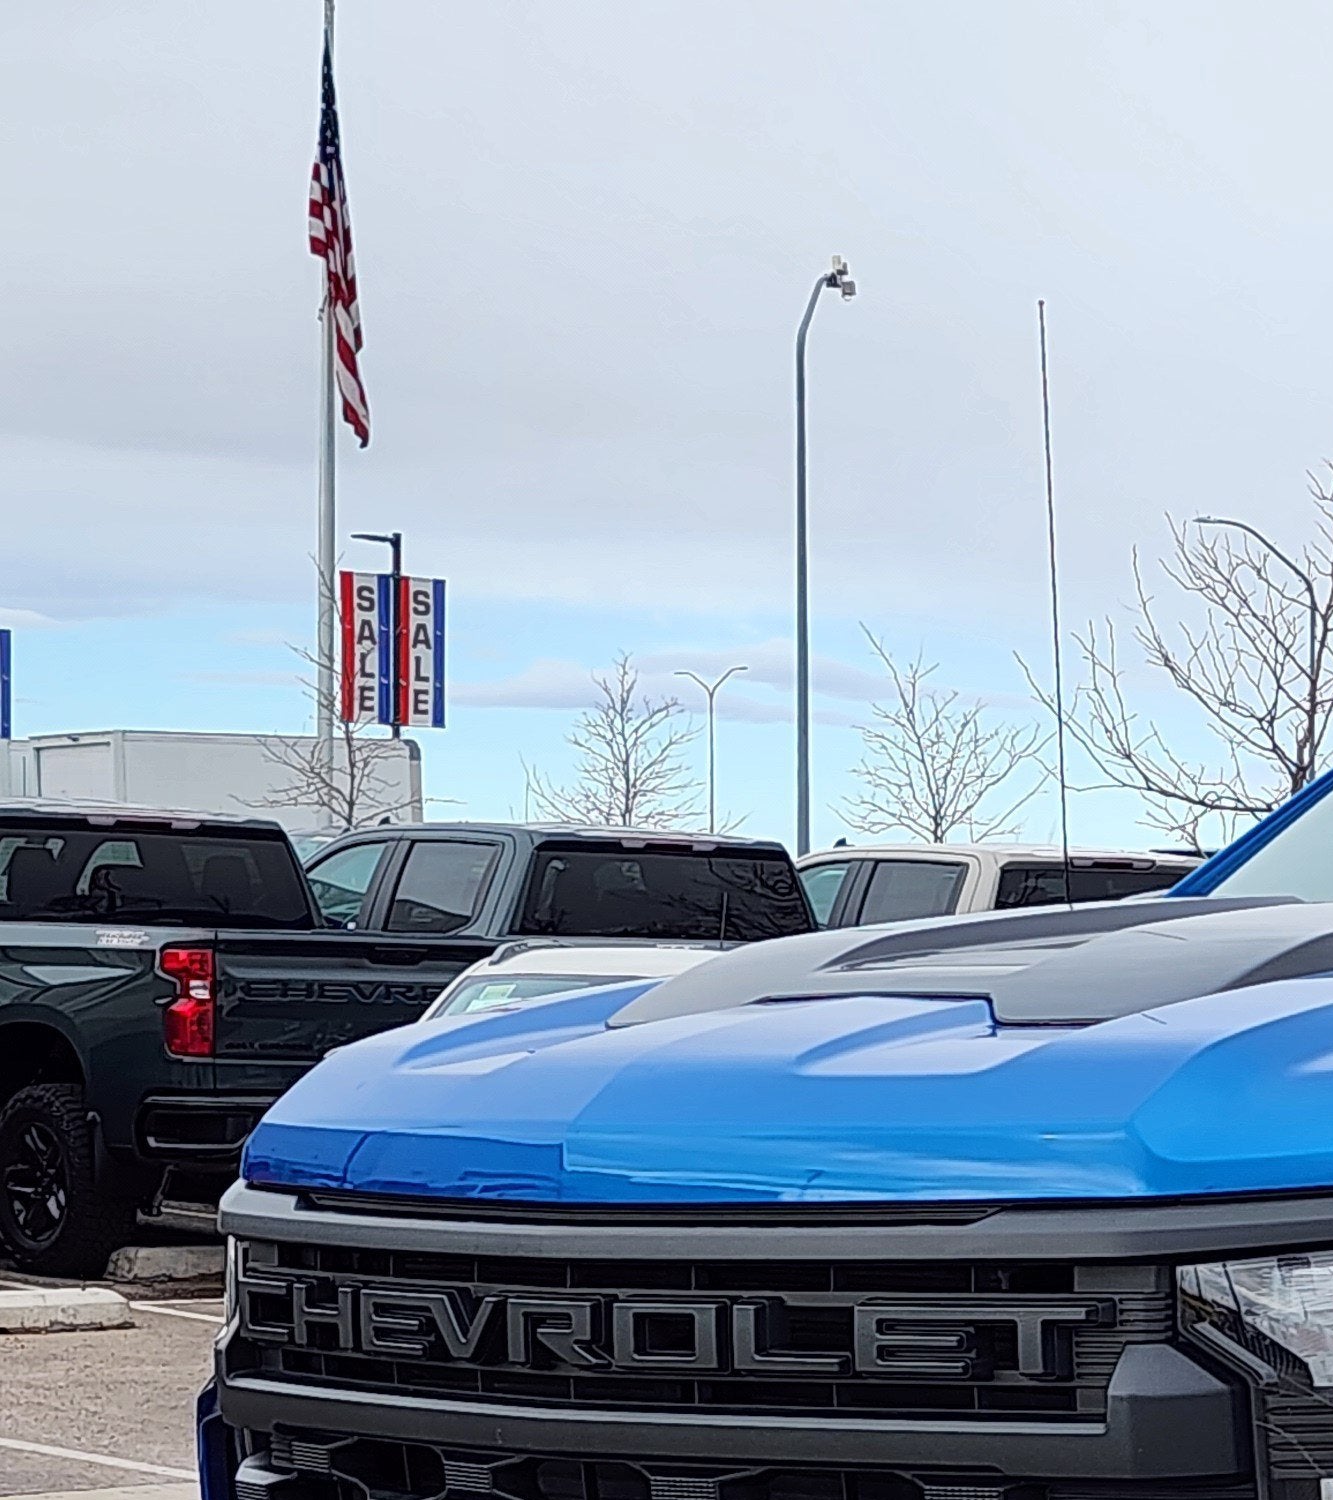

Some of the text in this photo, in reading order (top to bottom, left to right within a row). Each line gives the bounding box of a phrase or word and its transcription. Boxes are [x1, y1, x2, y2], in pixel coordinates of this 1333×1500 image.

[356, 585, 377, 712] SALE
[412, 590, 432, 715] SALE
[238, 1276, 1092, 1378] CHEVROLET
